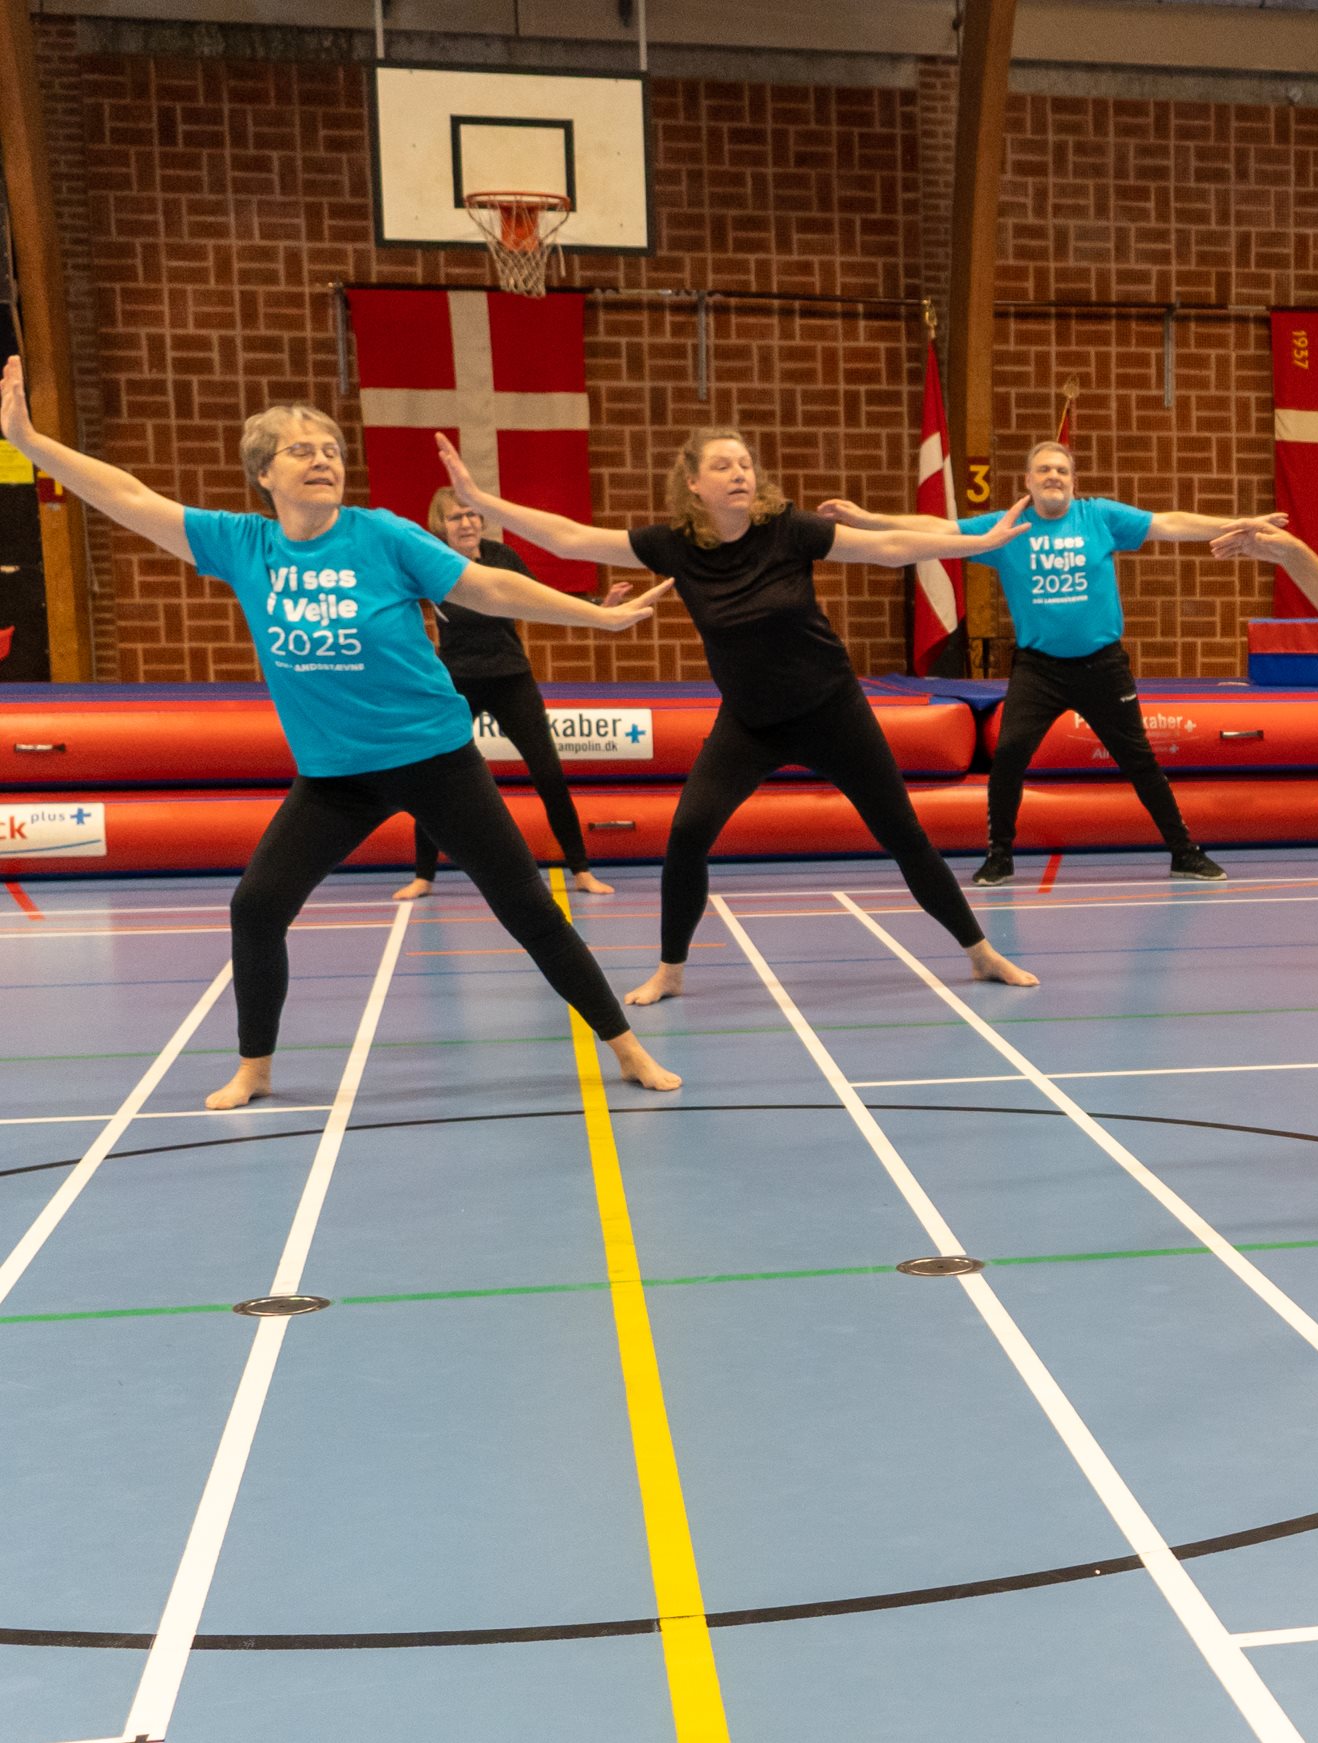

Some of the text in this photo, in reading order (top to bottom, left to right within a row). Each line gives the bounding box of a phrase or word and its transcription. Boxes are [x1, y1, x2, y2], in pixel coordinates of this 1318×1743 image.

[967, 465, 990, 503] 3
[1029, 535, 1050, 551] Vi
[1030, 551, 1086, 571] i Vejle
[269, 565, 357, 593] Vi ses
[1032, 572, 1088, 594] 2025
[267, 592, 358, 626] i Vejle
[268, 626, 361, 656] 2025
[31, 811, 65, 824] plus
